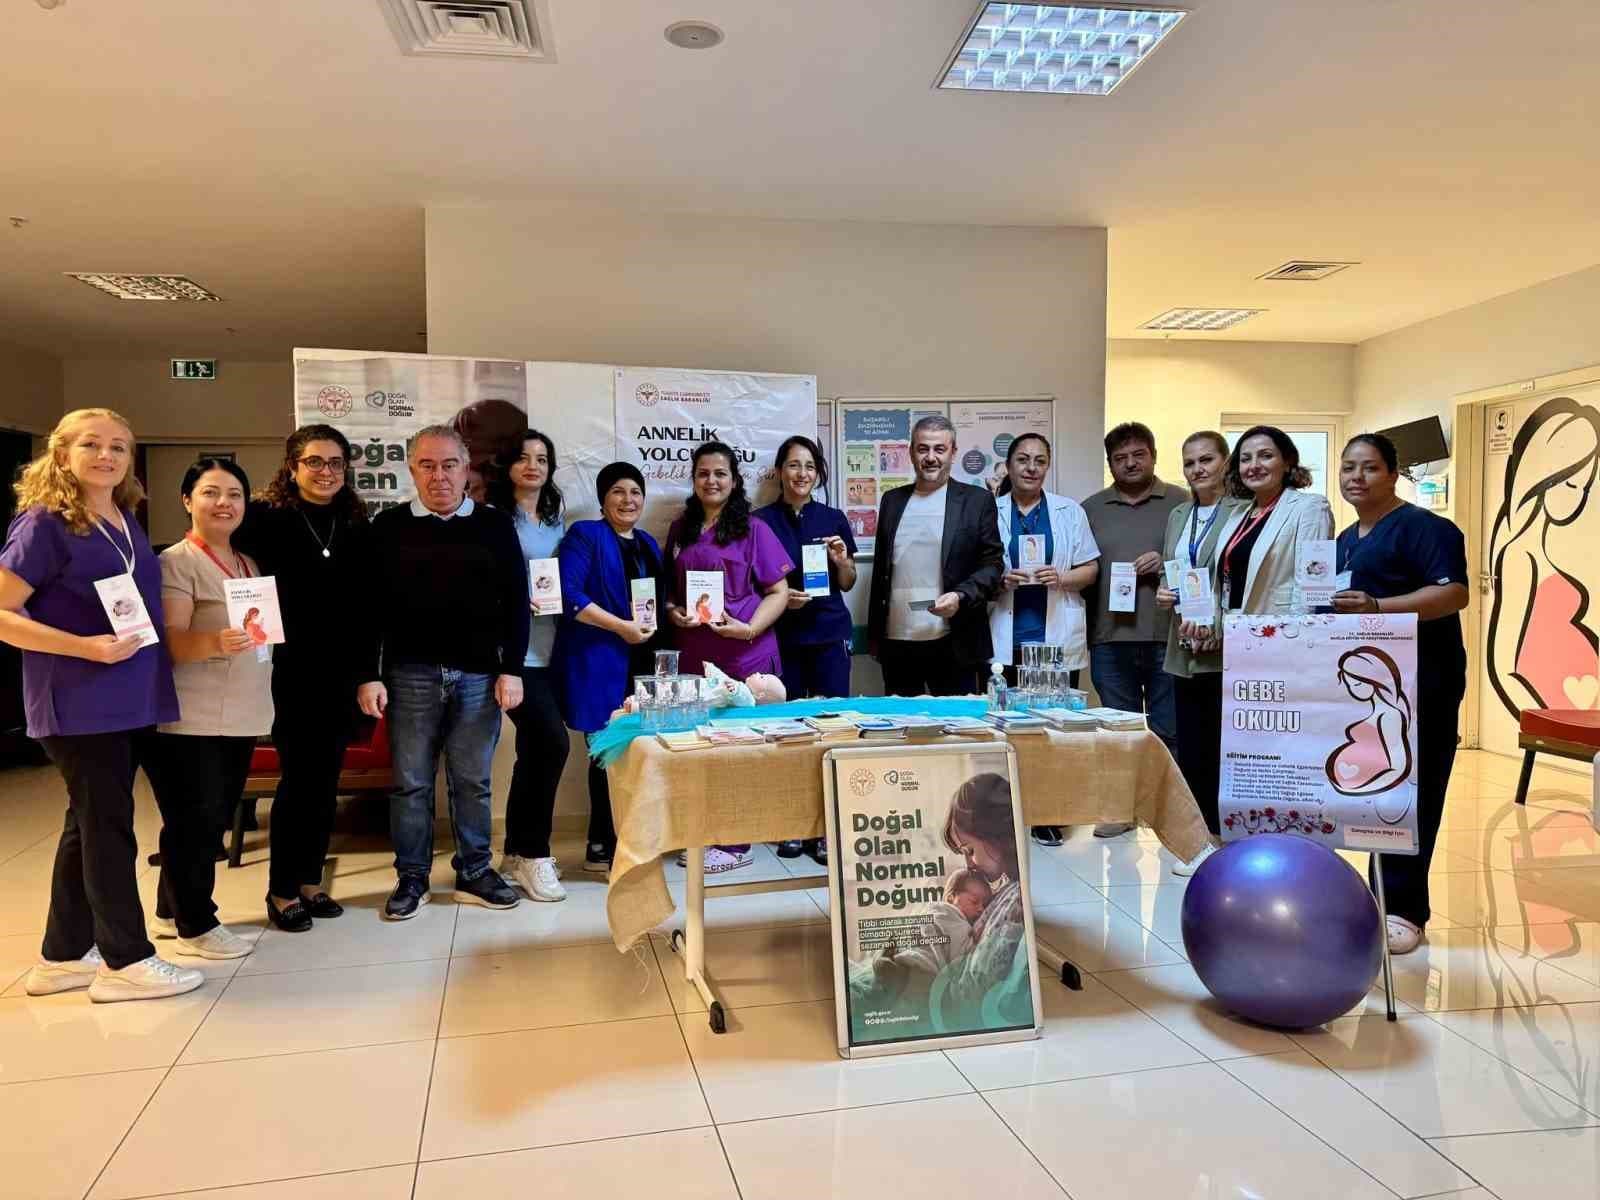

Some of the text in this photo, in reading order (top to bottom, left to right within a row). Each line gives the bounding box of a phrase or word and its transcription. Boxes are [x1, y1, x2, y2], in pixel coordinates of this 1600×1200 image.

[637, 423, 720, 441] ANNELİK
[1233, 679, 1286, 702] GEBE
[1232, 708, 1301, 733] OKULU
[852, 808, 923, 835] Doğal
[854, 836, 912, 856] Olan
[856, 856, 945, 881] Normal
[857, 883, 945, 910] Doğum
